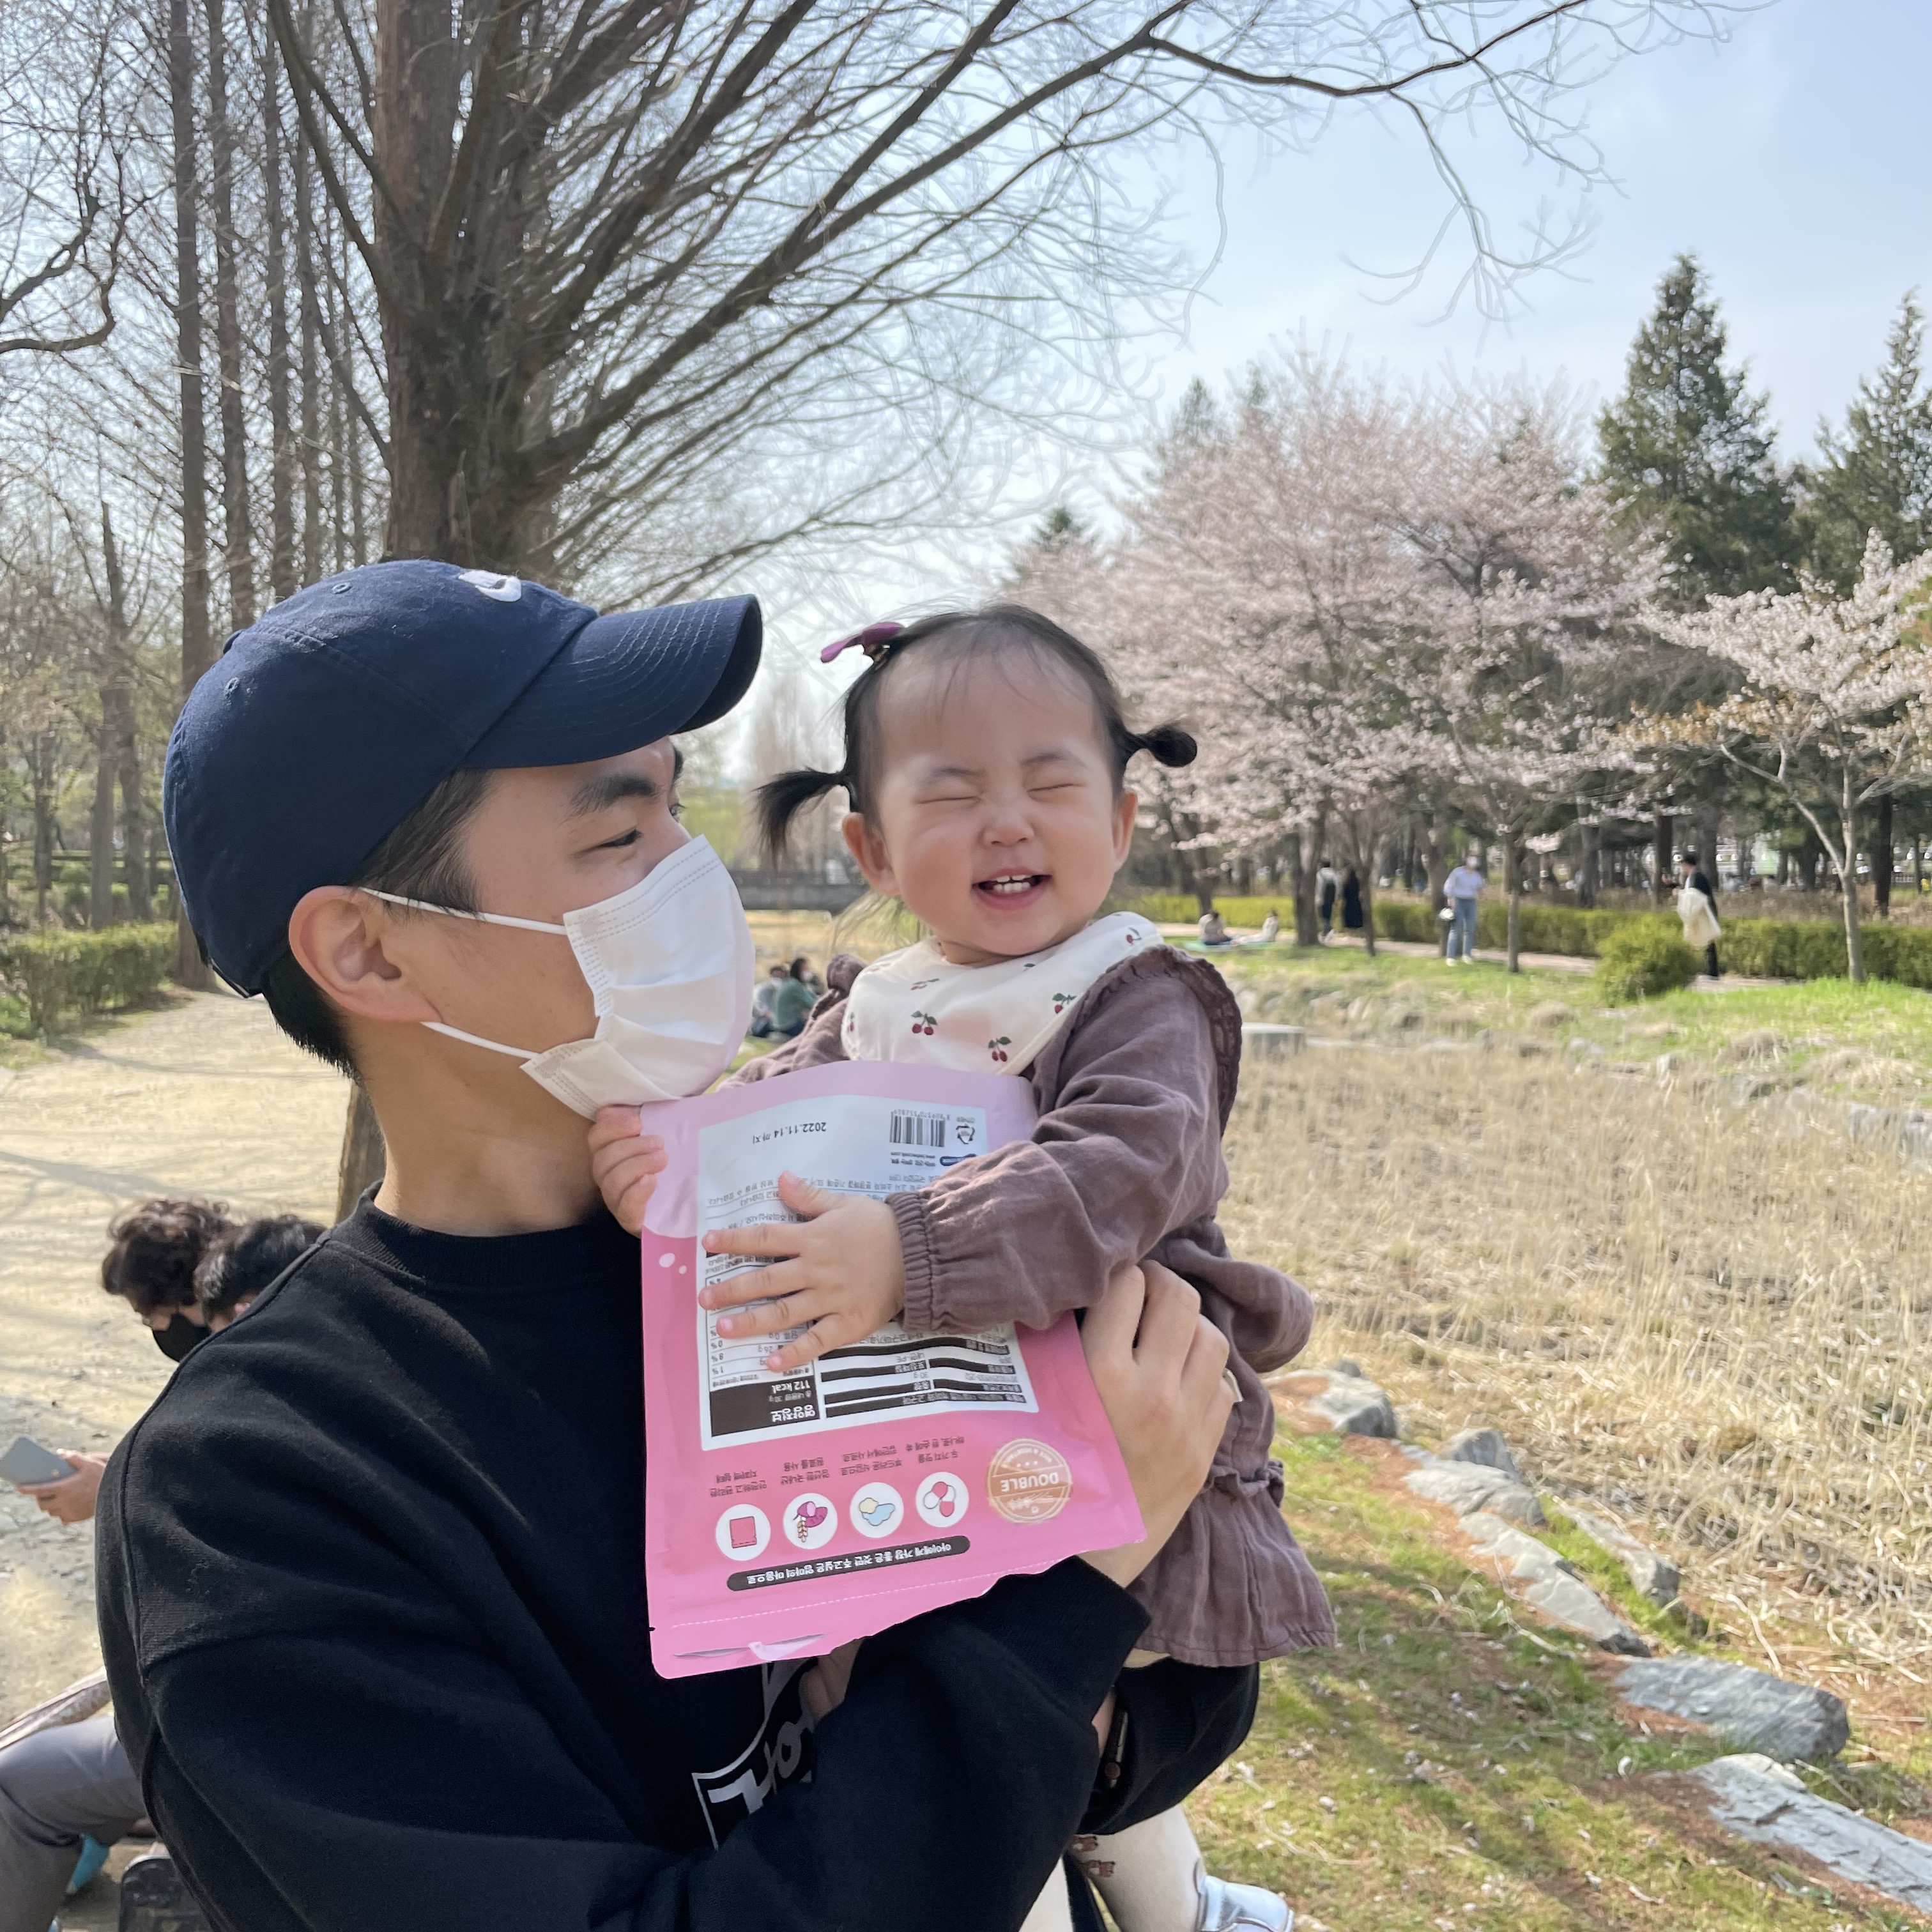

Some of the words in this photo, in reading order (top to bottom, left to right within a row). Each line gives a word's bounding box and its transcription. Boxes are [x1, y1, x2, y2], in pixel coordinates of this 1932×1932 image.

[774, 1122, 827, 1138] 2022.11.14
[753, 1133, 771, 1144] 까지
[772, 1383, 792, 1394] kcal
[794, 1380, 810, 1390] 112
[770, 1404, 816, 1423] 영양정보
[840, 1464, 870, 1476] 식감으로
[873, 1459, 902, 1471] 부드러운
[781, 1474, 804, 1485] 국내산
[999, 1471, 1059, 1492] DOUBLE
[894, 1548, 913, 1560] 가장
[914, 1542, 952, 1556] 아이에게
[815, 1558, 852, 1573] 주고싶은
[854, 1554, 873, 1567] 것만
[785, 1563, 814, 1578] 엄마의
[746, 1570, 784, 1585] 마음으로
